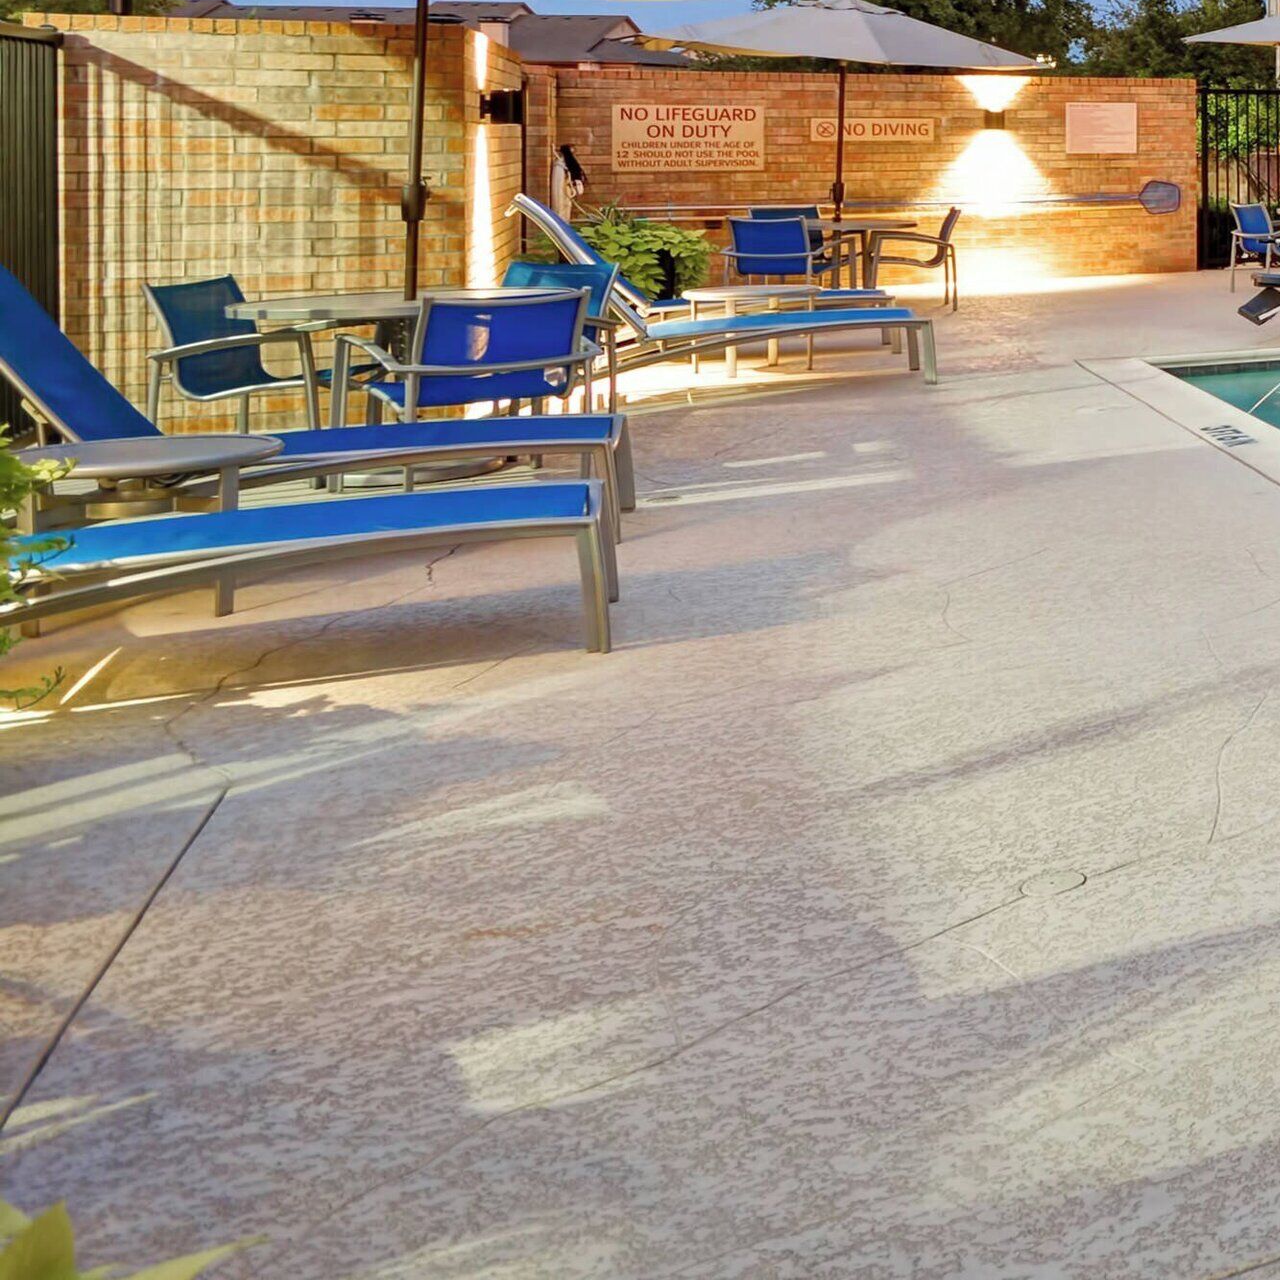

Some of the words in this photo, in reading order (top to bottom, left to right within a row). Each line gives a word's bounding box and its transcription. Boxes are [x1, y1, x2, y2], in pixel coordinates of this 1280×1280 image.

[620, 107, 648, 121] NO
[656, 107, 757, 122] LIFEGUARD
[646, 124, 675, 138] ON
[682, 124, 732, 138] DUTY
[843, 123, 865, 136] NO
[871, 123, 929, 136] DIVING
[621, 141, 667, 149] CHILDREN
[670, 141, 702, 149] UNDER
[704, 141, 721, 149] THE
[723, 141, 741, 149] AGE
[743, 141, 755, 149] OF
[616, 150, 629, 159] 12
[633, 150, 672, 159] SHOULD
[674, 150, 694, 159] NOT
[696, 150, 713, 159] USE
[717, 150, 733, 159] THE
[736, 150, 760, 159] POOL
[617, 159, 661, 168] WITHOUT
[663, 159, 693, 168] ADULT
